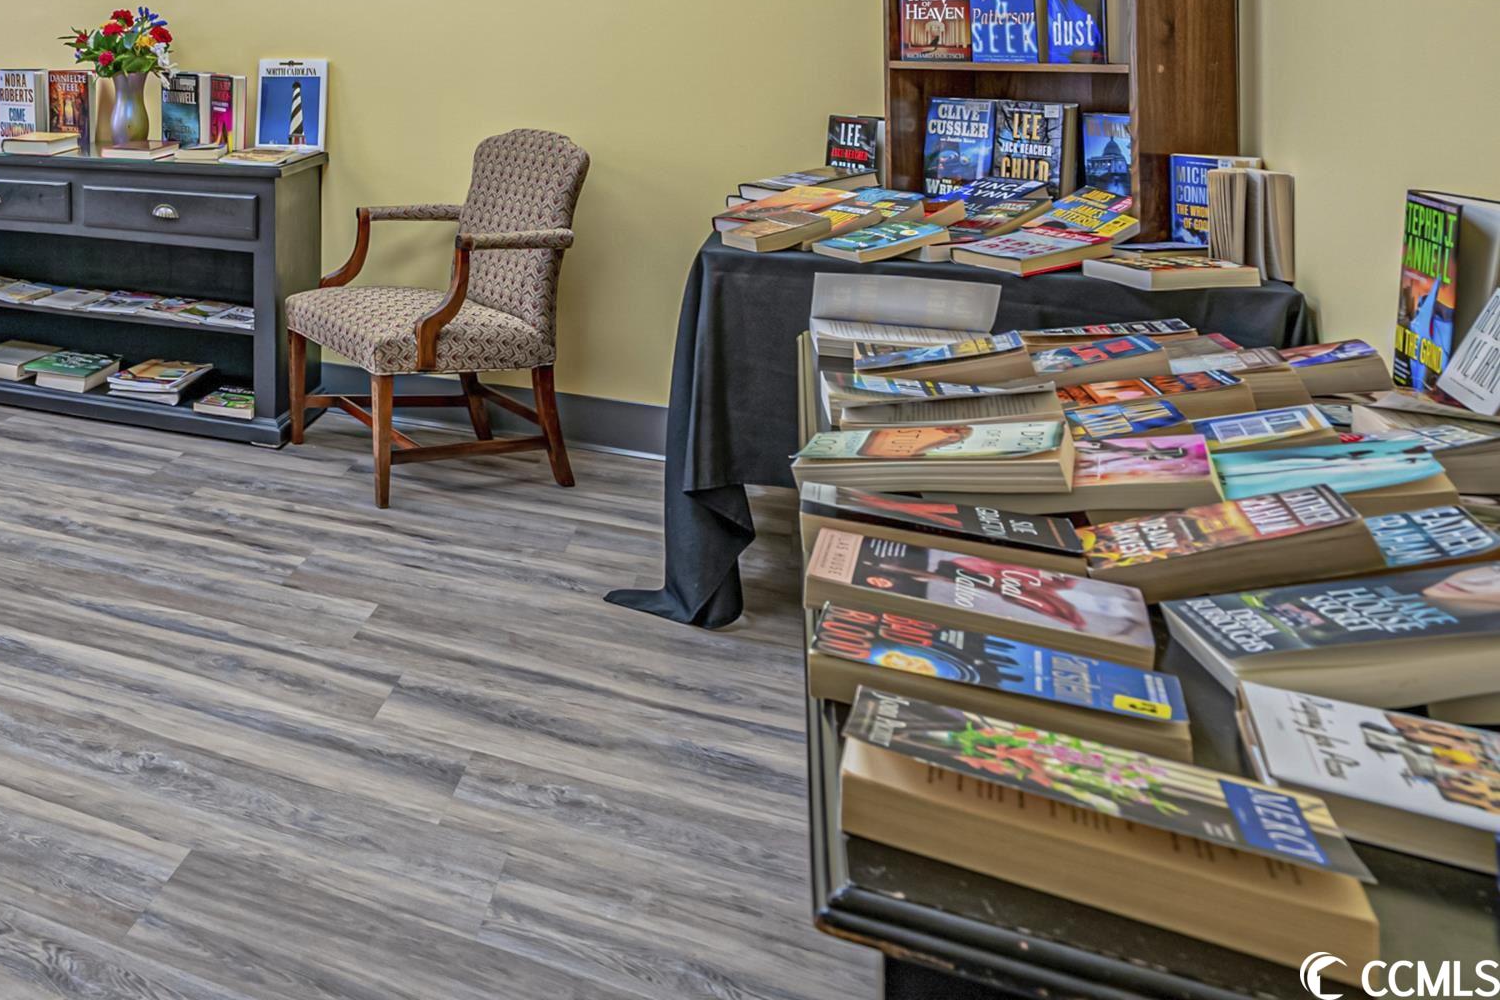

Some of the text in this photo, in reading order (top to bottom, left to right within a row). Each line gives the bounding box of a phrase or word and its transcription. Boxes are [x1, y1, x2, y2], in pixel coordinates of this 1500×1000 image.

[905, 3, 965, 23] HEAVEN
[973, 8, 1036, 27] Patterson
[972, 22, 1038, 54] SEEK
[1053, 13, 1094, 47] dust
[4, 73, 27, 87] NORA
[50, 74, 87, 83] DANIELLE
[265, 67, 317, 76] NORTH CAROLINA
[0, 88, 34, 102] ROBERTS
[58, 83, 79, 91] STEEL
[8, 107, 26, 122] COME
[938, 103, 981, 122] CLIVE
[840, 122, 862, 146] LEE
[928, 119, 989, 138] CUSSLER
[1012, 112, 1041, 140] LEE
[1000, 142, 1052, 156] JACK REACHER
[1001, 156, 1050, 181] CHILD
[1176, 166, 1208, 185] MICH
[955, 184, 1015, 200] FLYNN
[971, 179, 1028, 193] VINCE
[1176, 203, 1189, 216] THE
[1183, 217, 1193, 229] OF
[1405, 202, 1445, 243] TEPHEN
[1403, 234, 1452, 284] ANNELL
[975, 506, 1006, 537] GRAFTON
[1009, 518, 1039, 536] SUE
[1140, 516, 1178, 549] DEADLY
[1110, 521, 1152, 558] HARVEST
[954, 568, 996, 608] Tattoo
[1001, 569, 1043, 608] Coal
[1228, 607, 1279, 637] DEBRA
[1301, 594, 1384, 632] SECRET
[1327, 586, 1426, 633] HOUSE
[1398, 595, 1460, 625] LAKE
[816, 605, 879, 660] BLOOD
[877, 612, 941, 648] BAD
[1185, 599, 1274, 653] BURROUGHS
[1250, 788, 1326, 863] MERCY
